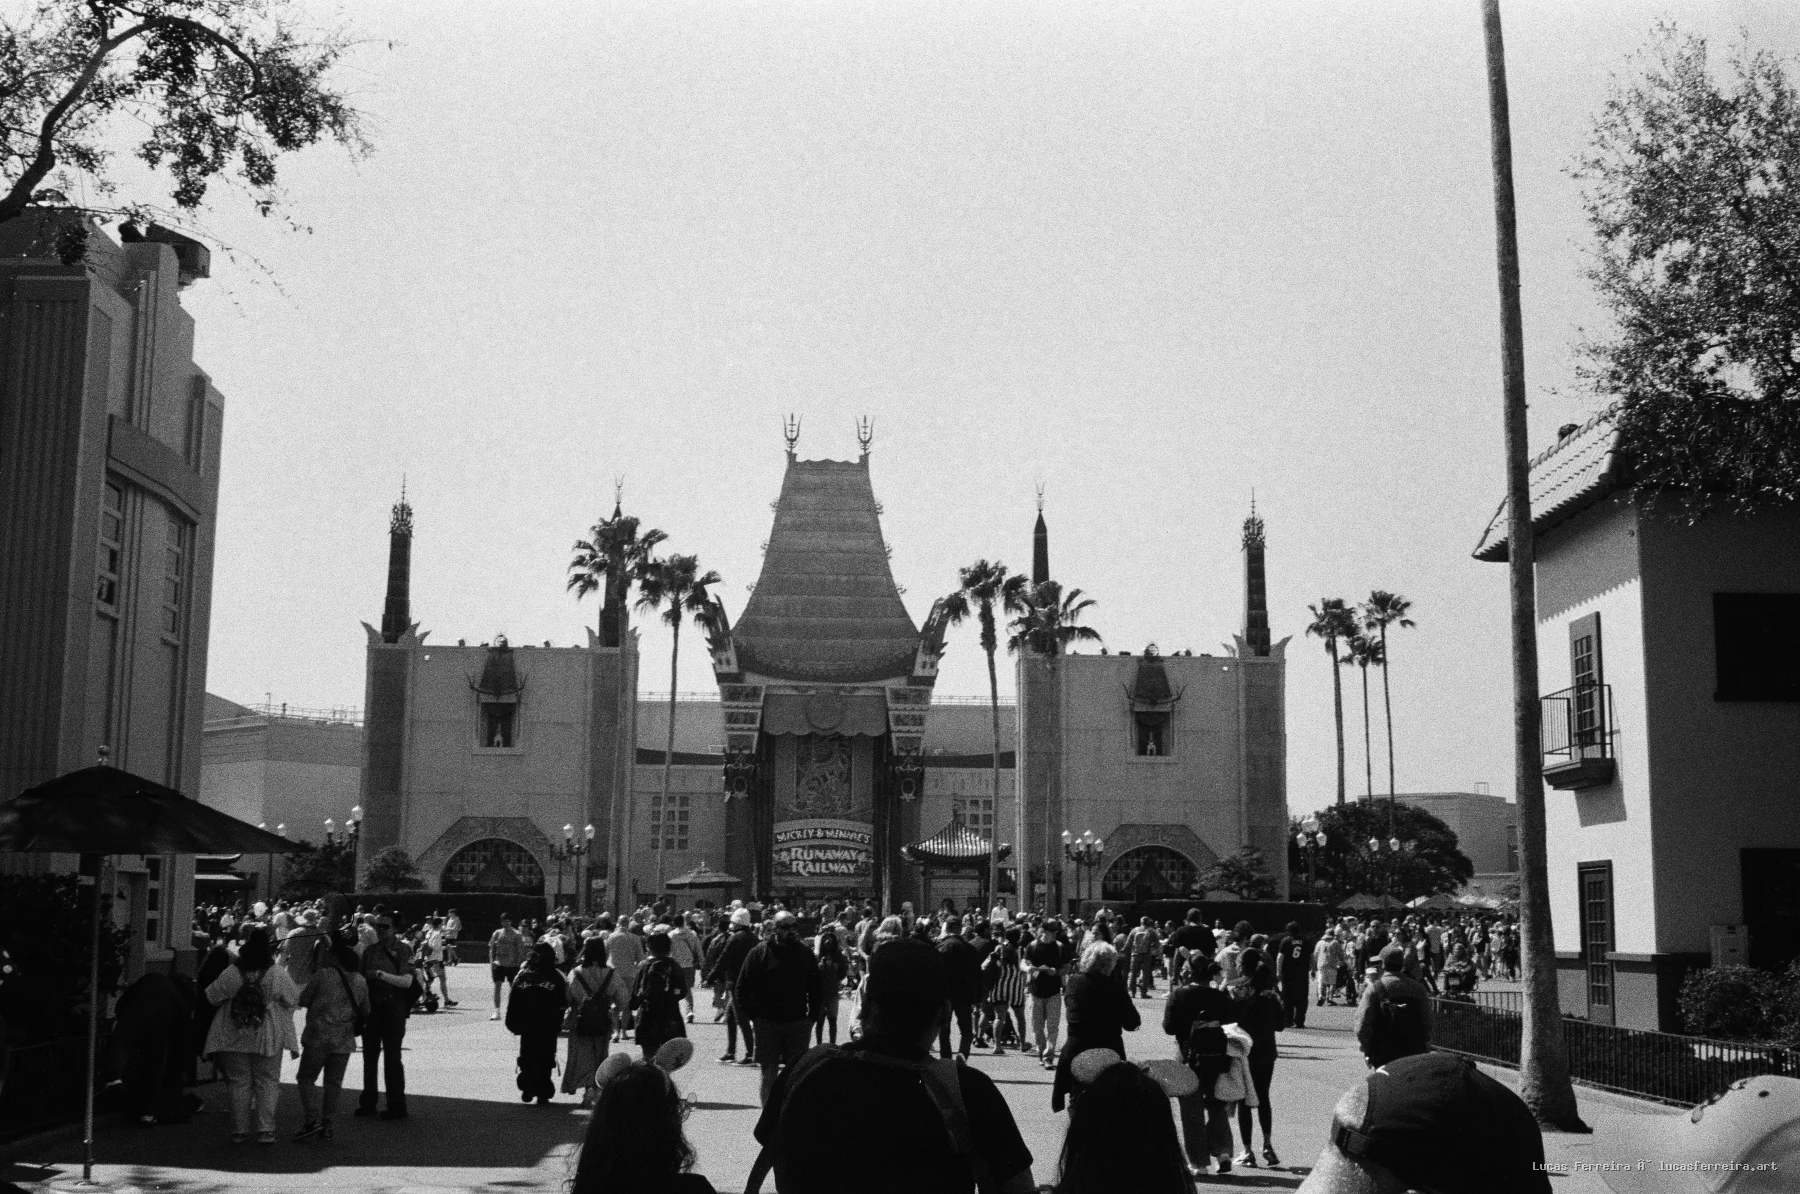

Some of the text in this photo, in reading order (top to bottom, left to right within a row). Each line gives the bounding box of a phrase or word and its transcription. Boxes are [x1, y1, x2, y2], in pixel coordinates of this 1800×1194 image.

[777, 829, 815, 842] MICKEY
[816, 829, 824, 838] &
[791, 847, 859, 861] RUNAWAY
[792, 861, 857, 877] RAILWAY
[1292, 946, 1302, 958] 6
